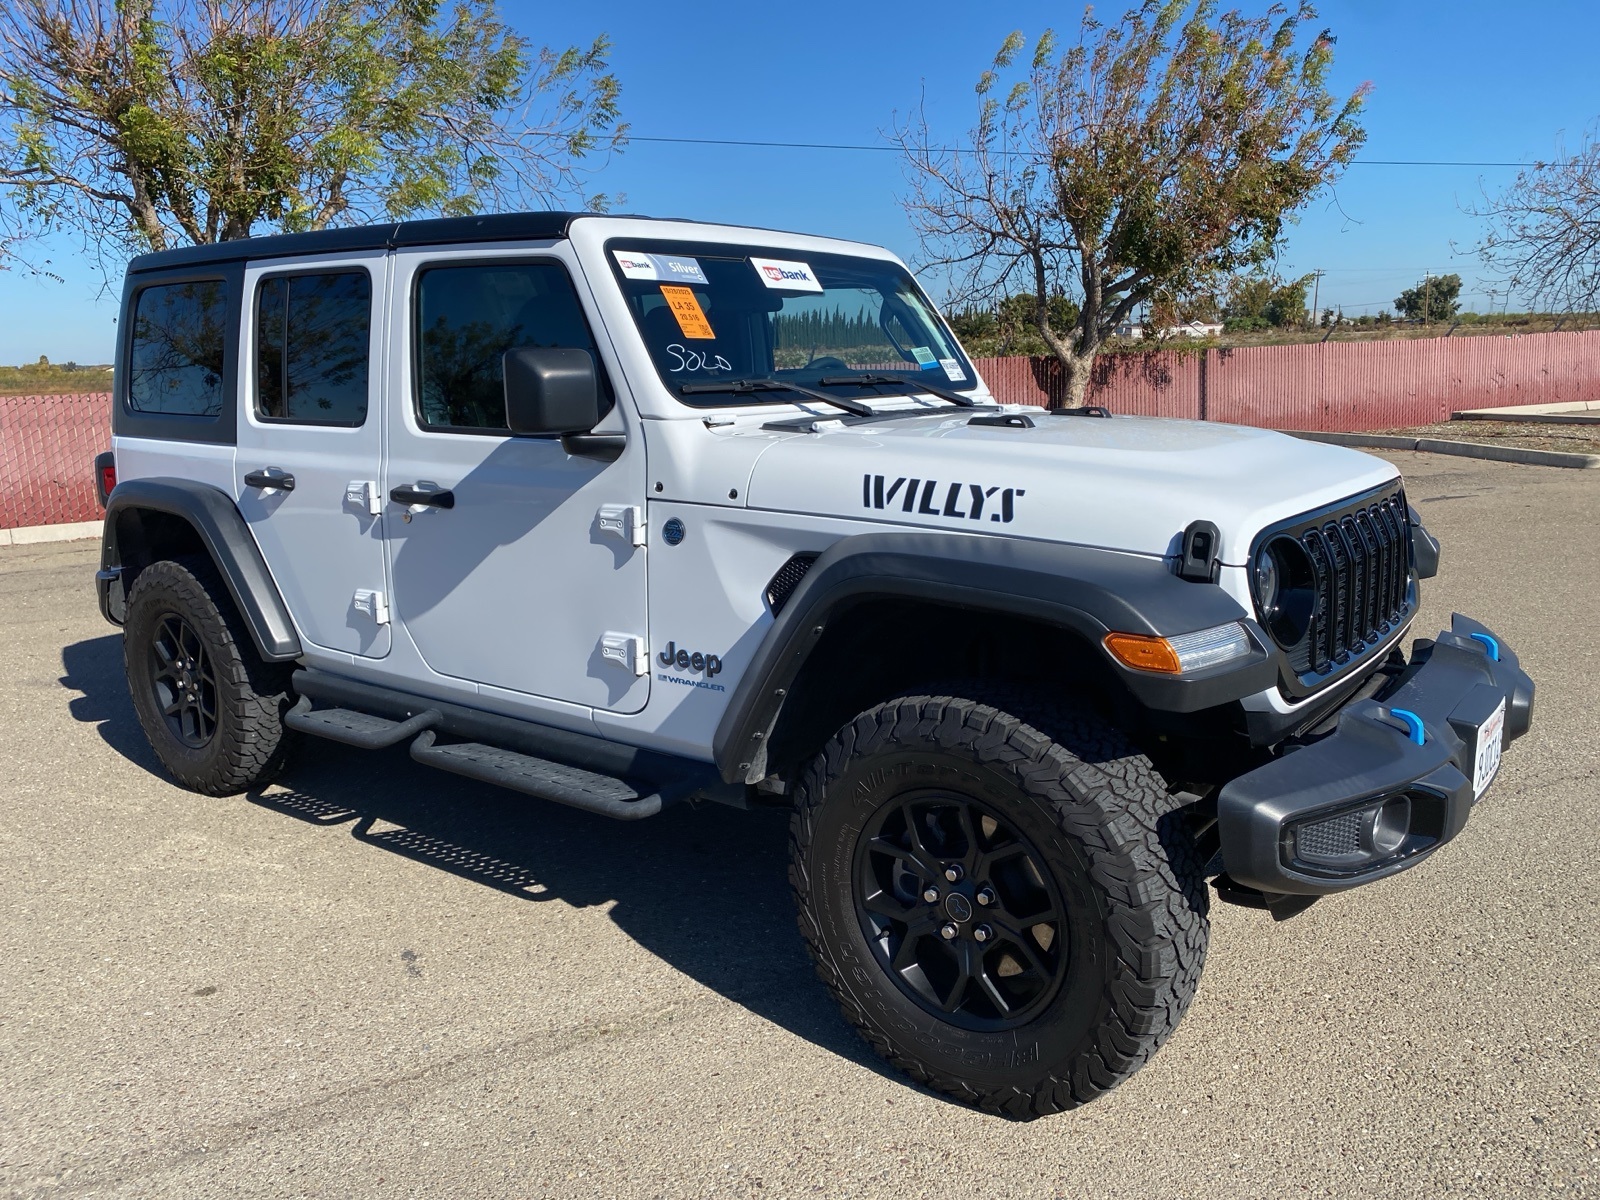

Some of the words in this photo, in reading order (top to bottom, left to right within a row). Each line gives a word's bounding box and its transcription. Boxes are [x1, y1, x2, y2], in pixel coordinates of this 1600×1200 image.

[668, 262, 699, 274] Silver
[672, 301, 685, 310] LA
[684, 302, 695, 311] 35
[666, 343, 731, 372] SOLD
[863, 474, 1026, 523] WILLYS
[659, 641, 722, 678] Jeep
[667, 675, 725, 693] WRANGLER
